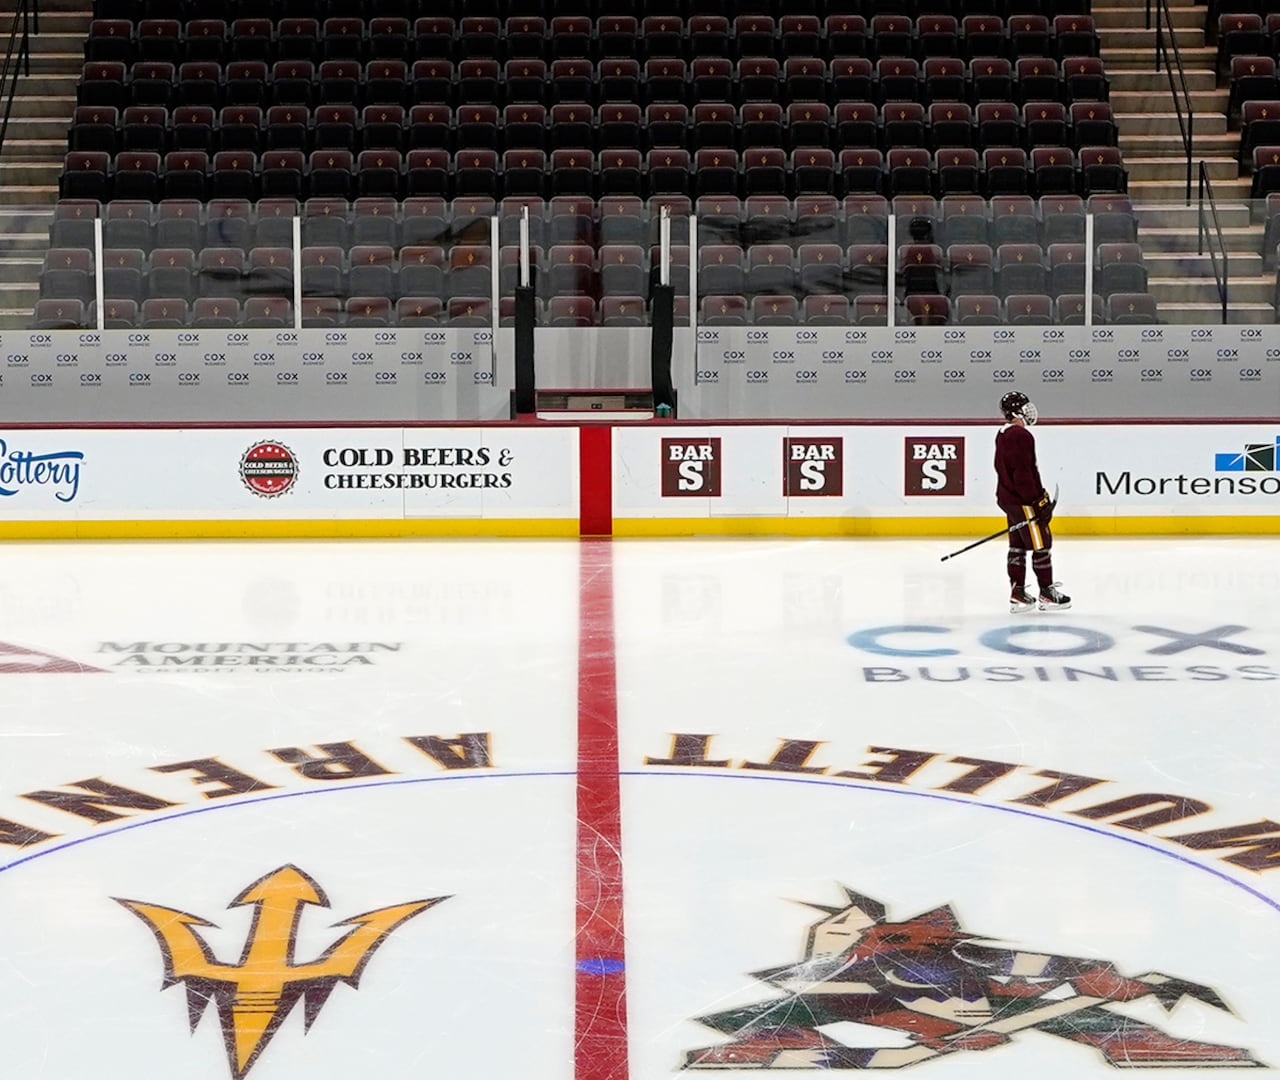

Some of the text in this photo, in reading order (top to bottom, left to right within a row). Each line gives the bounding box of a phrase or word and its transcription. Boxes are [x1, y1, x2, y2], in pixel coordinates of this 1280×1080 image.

[277, 333, 298, 342] COX
[326, 332, 348, 341] COX
[425, 332, 446, 341] COX
[797, 331, 818, 340] COX
[846, 331, 867, 340] COX
[1143, 329, 1164, 338] COX
[1242, 329, 1263, 338] COX
[80, 334, 101, 343] COX
[130, 334, 150, 343] COX
[156, 353, 177, 362] COX
[205, 352, 226, 362] COX
[304, 352, 324, 361] COX
[353, 352, 374, 361] COX
[725, 350, 746, 360] COX
[873, 350, 894, 359] COX
[922, 350, 943, 359] COX
[1021, 350, 1041, 359] COX
[1070, 349, 1091, 359] COX
[1218, 348, 1239, 358] COX
[8, 354, 29, 363] COX
[179, 372, 201, 381] COX
[229, 372, 249, 381] COX
[376, 371, 397, 381] COX
[425, 371, 447, 380] COX
[748, 370, 769, 379] COX
[797, 370, 818, 379] COX
[896, 369, 916, 379] COX
[945, 370, 966, 379] COX
[994, 369, 1015, 379] COX
[1043, 369, 1065, 378] COX
[1093, 369, 1114, 378] COX
[1142, 368, 1163, 378] COX
[1191, 368, 1212, 377] COX
[32, 374, 53, 383] COX
[81, 373, 102, 382] COX
[323, 448, 513, 467] COLD BEERS &
[670, 446, 713, 462] BAR
[792, 445, 834, 462] BAR
[913, 445, 957, 462] BAR
[679, 461, 703, 490] S
[801, 461, 825, 490] S
[922, 461, 946, 490] S
[323, 474, 513, 490] CHEESEBURGERS
[846, 625, 1267, 657] COX
[96, 641, 408, 653] MOUNTAIN
[113, 653, 377, 666] AMERICA
